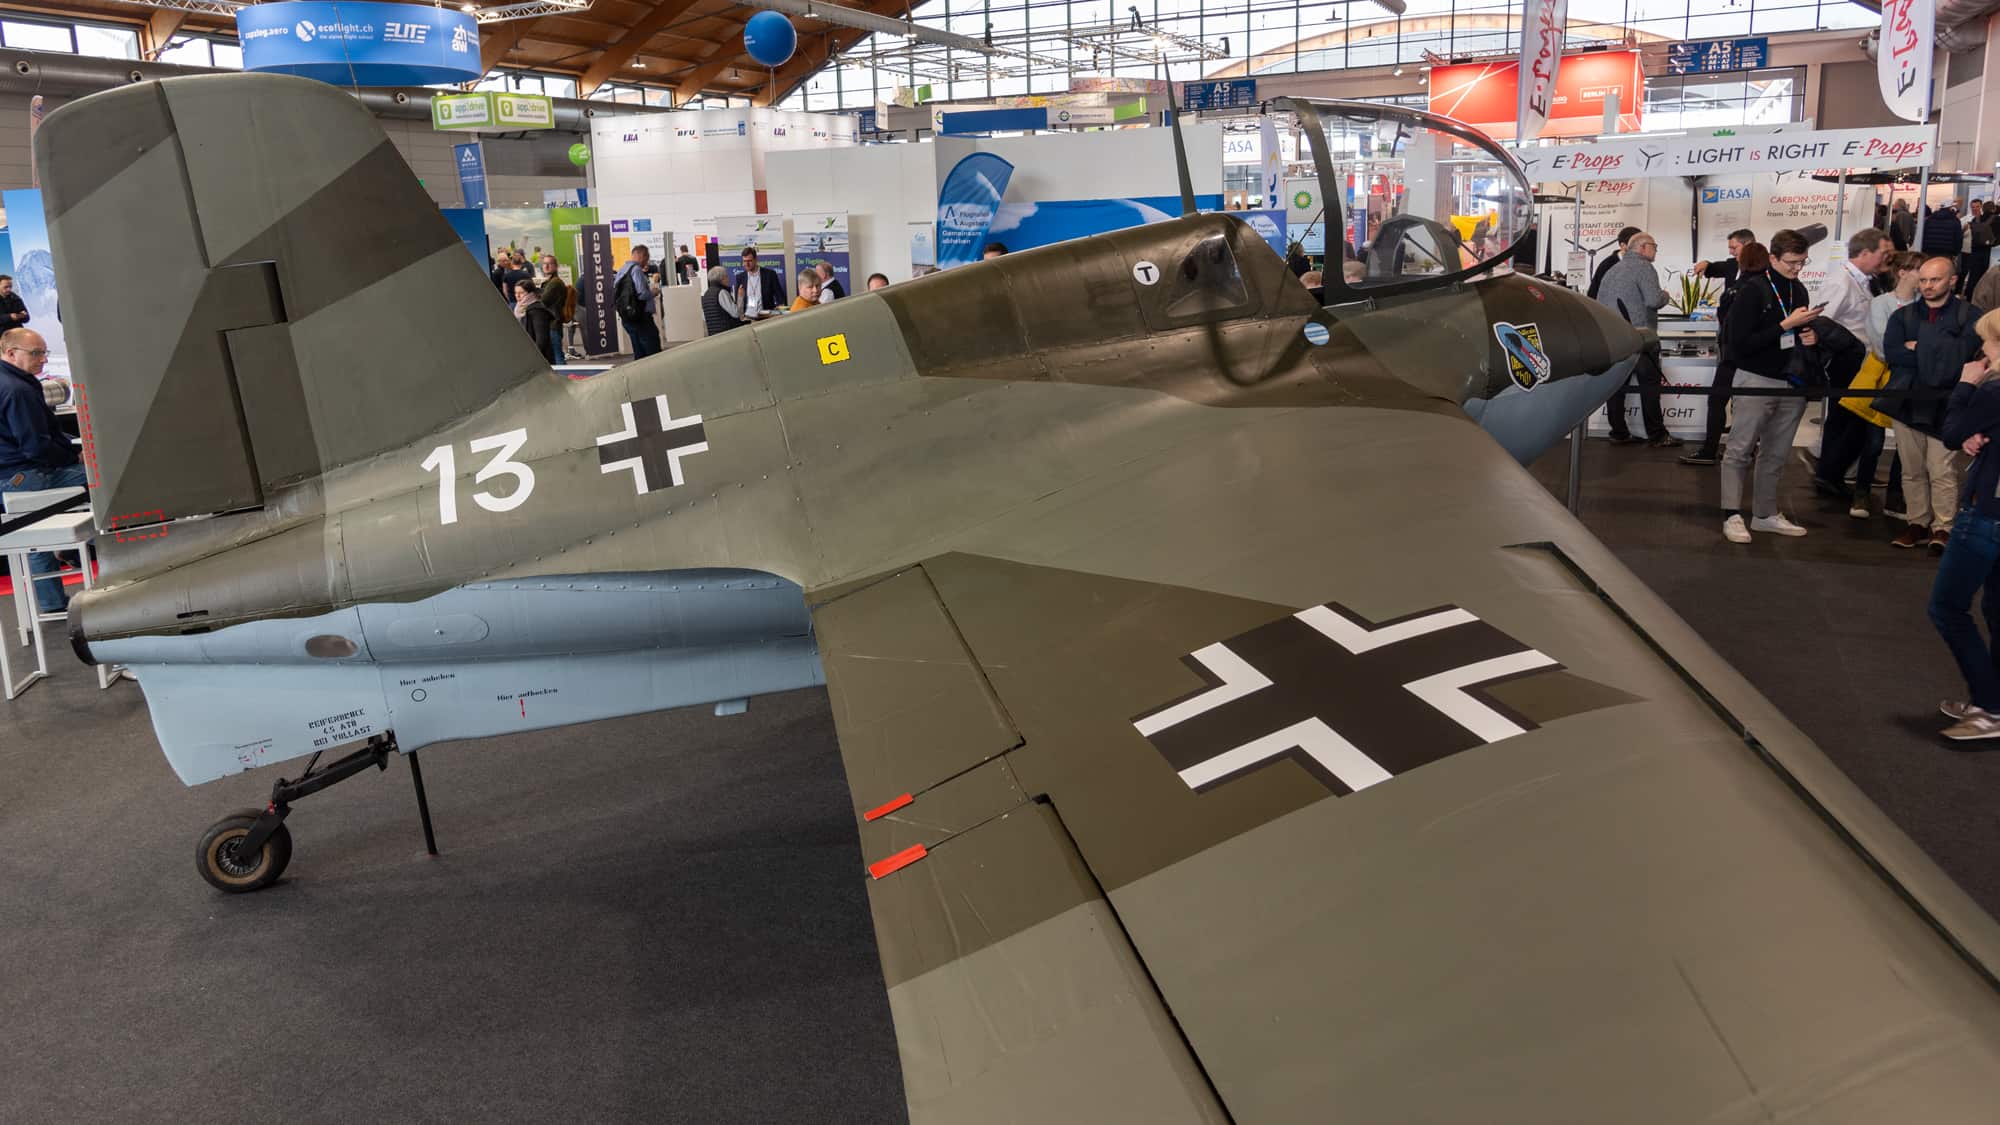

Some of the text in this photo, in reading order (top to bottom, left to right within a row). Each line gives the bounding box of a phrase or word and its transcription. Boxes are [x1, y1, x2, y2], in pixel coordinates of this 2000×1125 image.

[318, 23, 374, 34] ecoflight.ch
[384, 22, 429, 40] ELITE
[1709, 41, 1732, 54] A5
[1213, 82, 1230, 93] A5
[1552, 152, 1624, 174] E-Props
[1687, 147, 1745, 164] LIGHT
[1767, 142, 1830, 160] RIGHT
[1842, 138, 1928, 163] E-Props
[1585, 181, 1634, 196] E-Props
[1720, 188, 1751, 200] EASA
[1770, 193, 1849, 204] CARBON SPACES
[1564, 222, 1601, 230] COSTANT
[1137, 266, 1153, 282] T
[593, 231, 607, 348] capzlog.aero
[828, 343, 839, 357] C
[1663, 408, 1696, 418] IGHT
[421, 427, 535, 525] 13
[332, 725, 371, 742] VOLLAST
